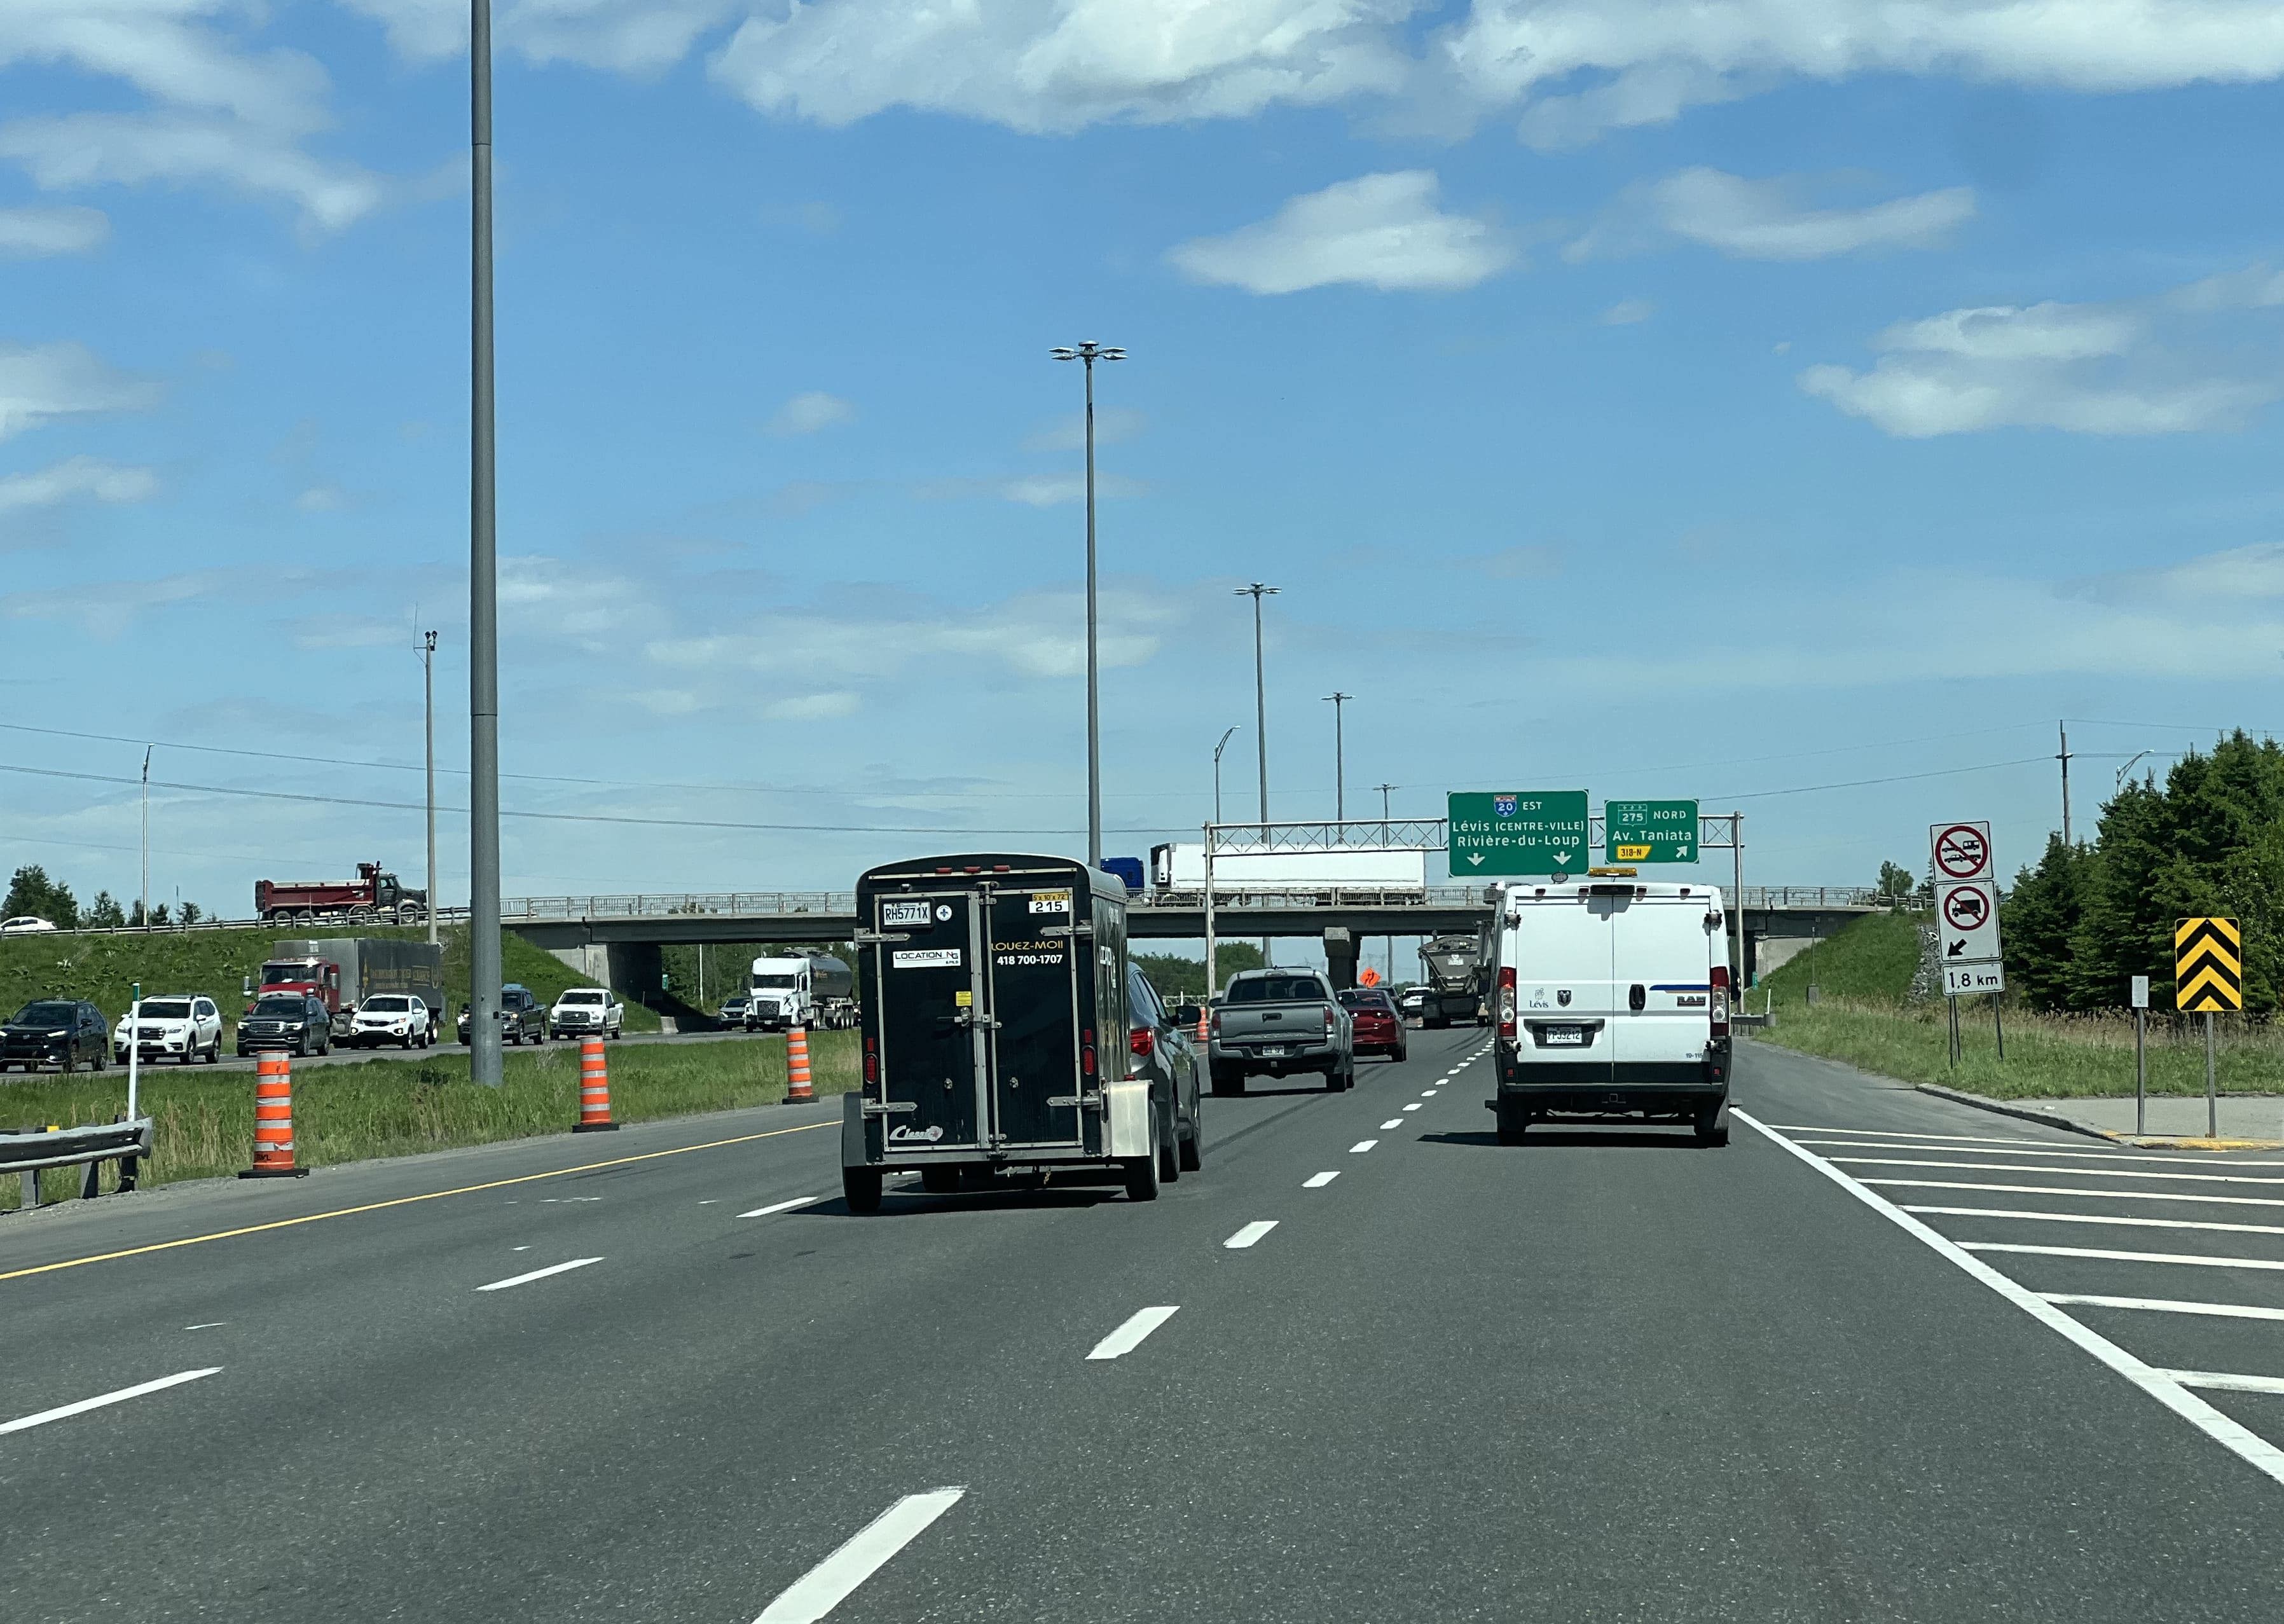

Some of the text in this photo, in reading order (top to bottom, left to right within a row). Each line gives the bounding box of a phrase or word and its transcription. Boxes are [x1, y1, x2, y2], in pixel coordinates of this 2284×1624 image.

[1498, 801, 1542, 811] 20 EST
[1622, 811, 1686, 822] 275 NORD
[1453, 820, 1584, 832] Lévis (CENTRE-VILLE)
[1613, 829, 1691, 841] Av. Taniata
[1457, 834, 1580, 848] Rivière-du-Loup
[1621, 848, 1642, 857] 318-N
[1036, 901, 1063, 912] 215
[884, 907, 928, 920] RH5771X
[997, 954, 1063, 965] 418 700-1707
[1949, 972, 1998, 989] 1,8 km
